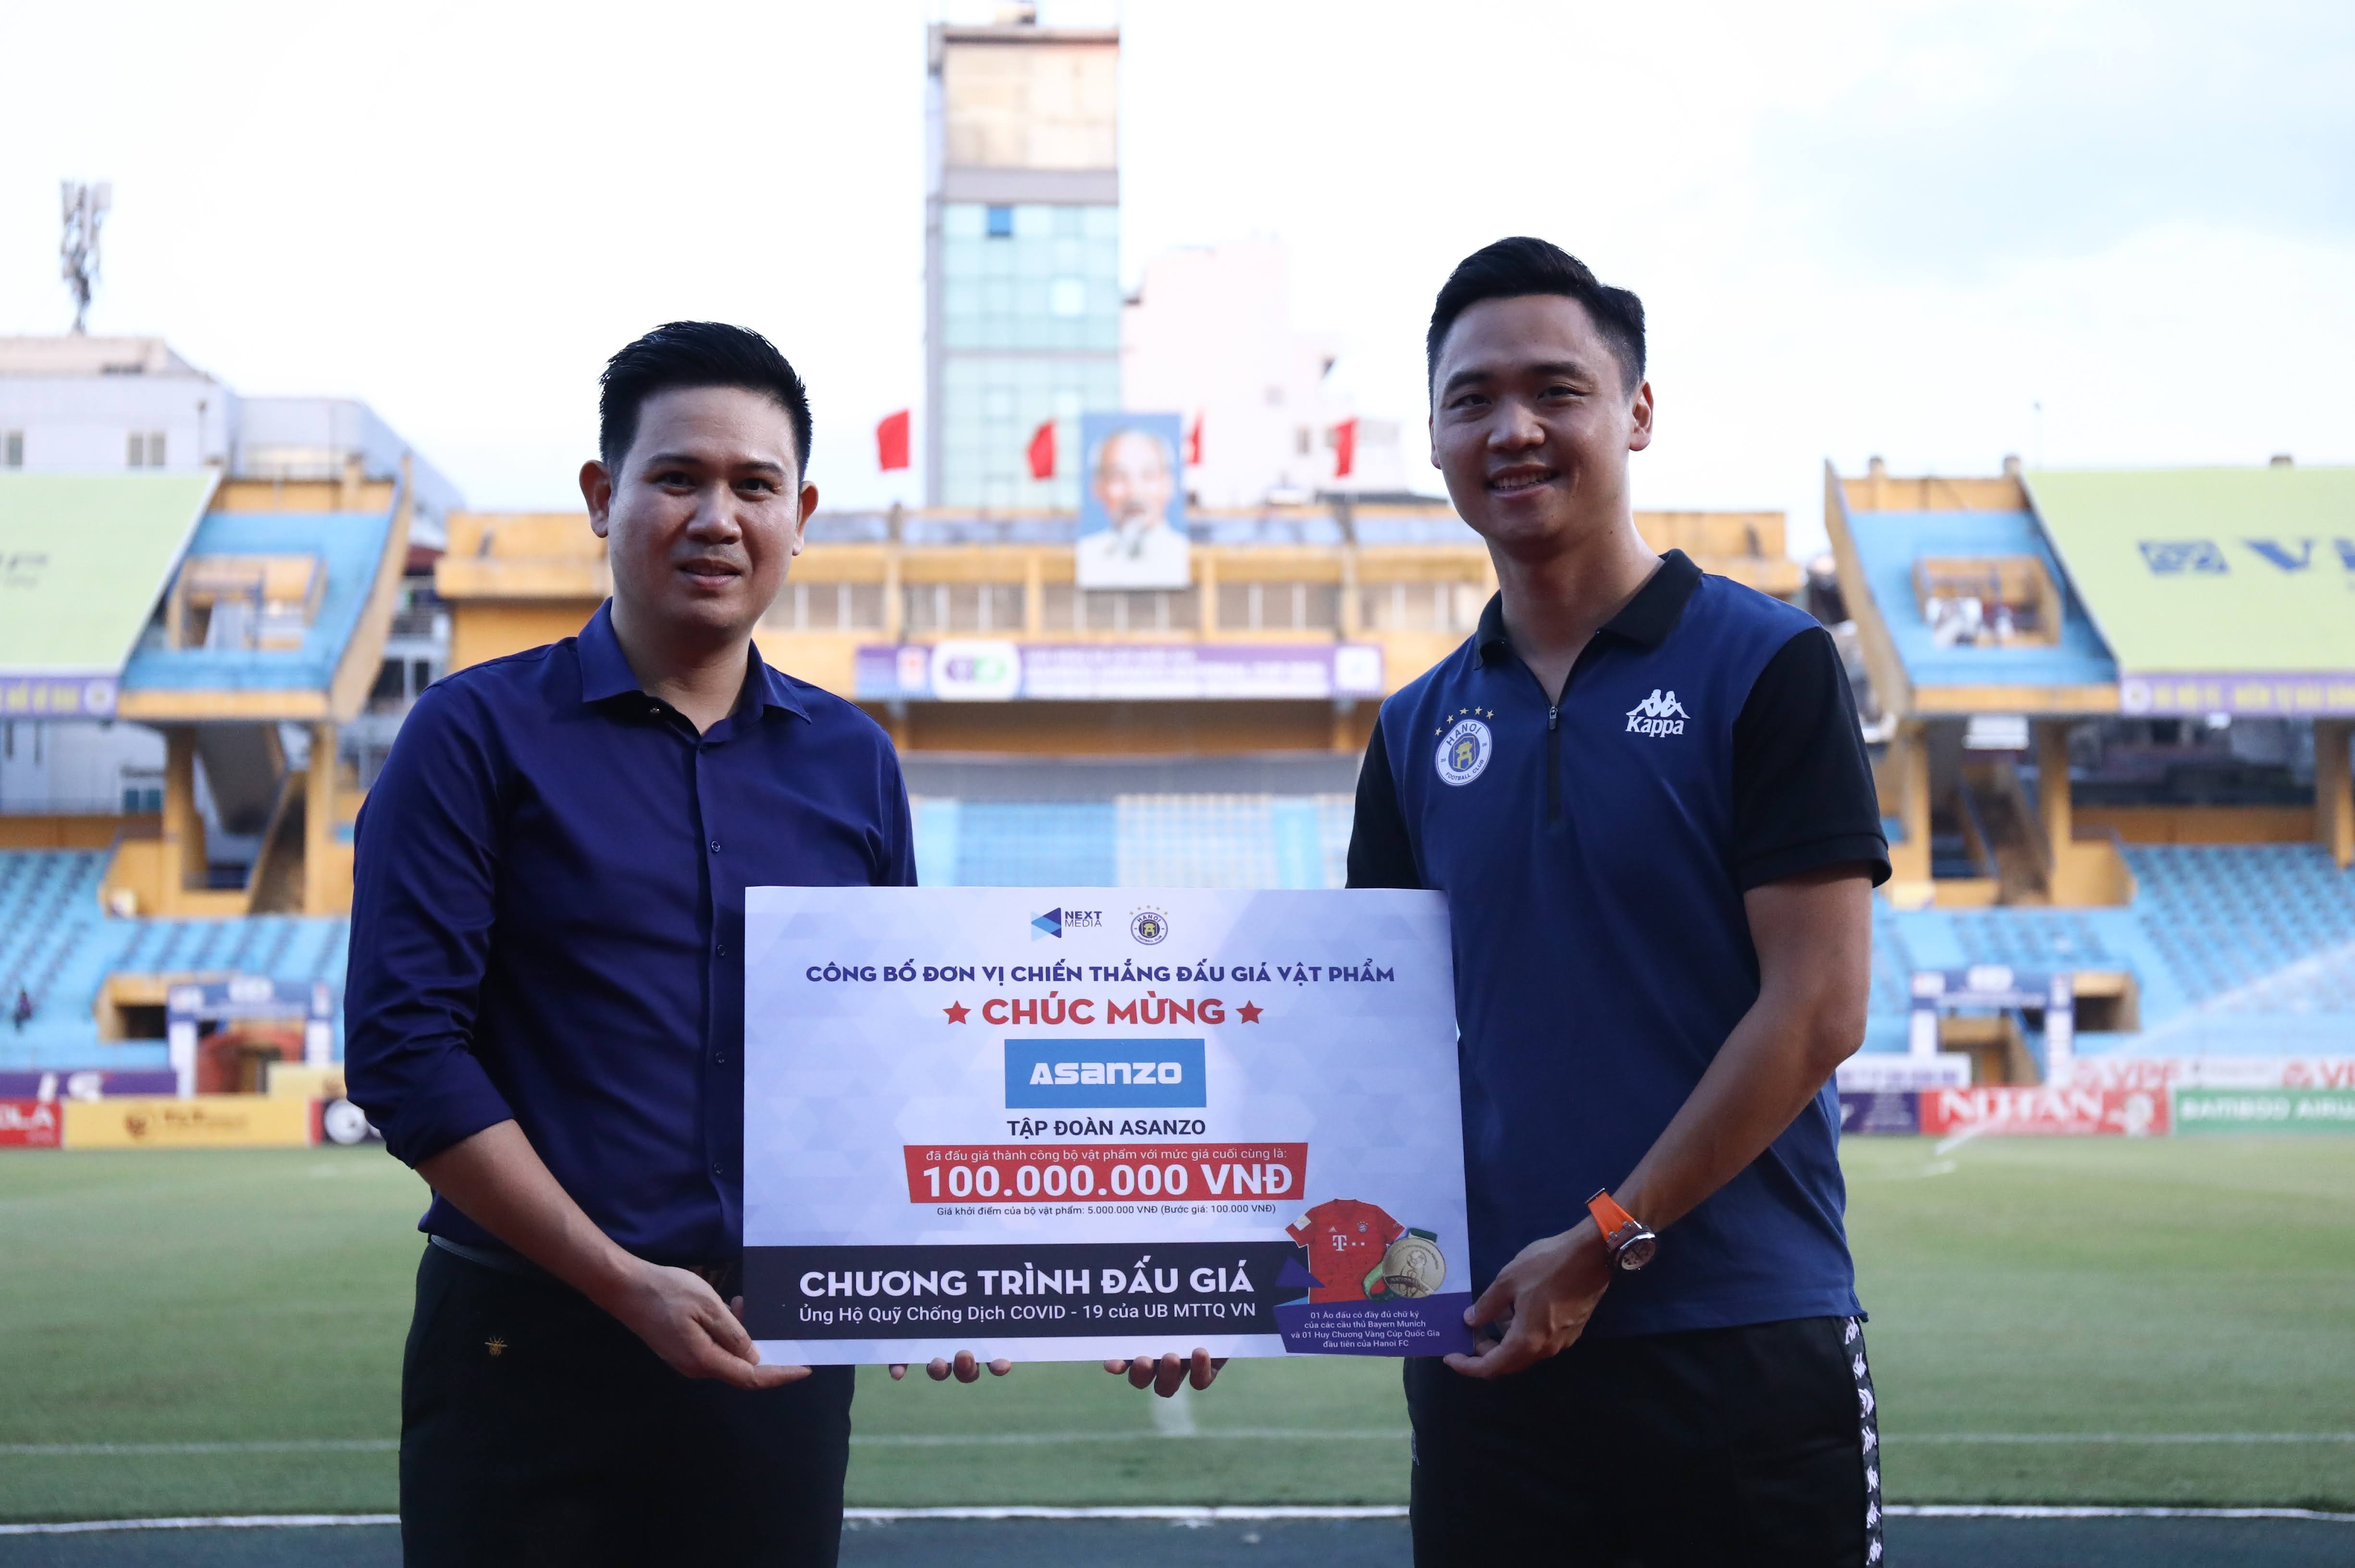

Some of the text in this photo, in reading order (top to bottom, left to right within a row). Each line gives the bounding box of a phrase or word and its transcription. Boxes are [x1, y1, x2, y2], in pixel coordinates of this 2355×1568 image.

[1446, 723, 1481, 746] HANOI
[1625, 716, 1684, 738] Kappa
[1445, 760, 1484, 781] FOOTBALL CLUB
[806, 958, 1394, 986] CÔNG BỐ ĐƠN VỊ CHIẾN THẮNG ĐẤU GIÁ VẬT PHẨM
[982, 991, 1225, 1025] CHÚC MỪNG
[1007, 1117, 1206, 1139] TẬP ĐOÀN ASANZO
[926, 1147, 1287, 1163] đã đấu giá thành công bộ vật phẩm với mức giá cuối cùng là:
[923, 1164, 1293, 1197] 100.000.000 VNĐ
[937, 1207, 952, 1215] Giá
[955, 1206, 975, 1215] khởi
[979, 1206, 1001, 1215] điểm
[1004, 1206, 1021, 1215] của
[1024, 1207, 1036, 1216] bộ
[1039, 1206, 1053, 1216] vật
[1055, 1205, 1085, 1217] phẩm:
[1087, 1206, 1134, 1214] 5.000.000
[1161, 1205, 1189, 1215] (Bước
[1192, 1205, 1208, 1215] giá:
[1251, 1204, 1276, 1214] VNĐ)
[800, 1255, 1255, 1297] CHƯƠNG TRÌNH ĐẤU GIÁ
[800, 1304, 833, 1325] Ủng
[839, 1307, 863, 1324] Hộ
[868, 1306, 901, 1324] Quỹ
[907, 1305, 962, 1324] Chống
[968, 1306, 1005, 1323] Dịch
[1011, 1305, 1065, 1320] COVID
[1083, 1305, 1103, 1319] 19
[1109, 1302, 1138, 1318] của
[1145, 1304, 1168, 1318] UB
[1174, 1303, 1225, 1320] MTTQ
[1231, 1302, 1256, 1317] VN
[1335, 1310, 1351, 1319] đấu
[1365, 1310, 1379, 1320] đầy
[1381, 1310, 1392, 1318] đủ
[1410, 1311, 1419, 1319] ký
[1315, 1332, 1330, 1340] Huy
[1332, 1331, 1363, 1339] Chương
[1365, 1330, 1385, 1339] Vàng
[1387, 1330, 1402, 1339] Cúp
[1405, 1328, 1425, 1338] Quốc
[1369, 1321, 1394, 1329] Bayern
[1323, 1339, 1338, 1348] đầu
